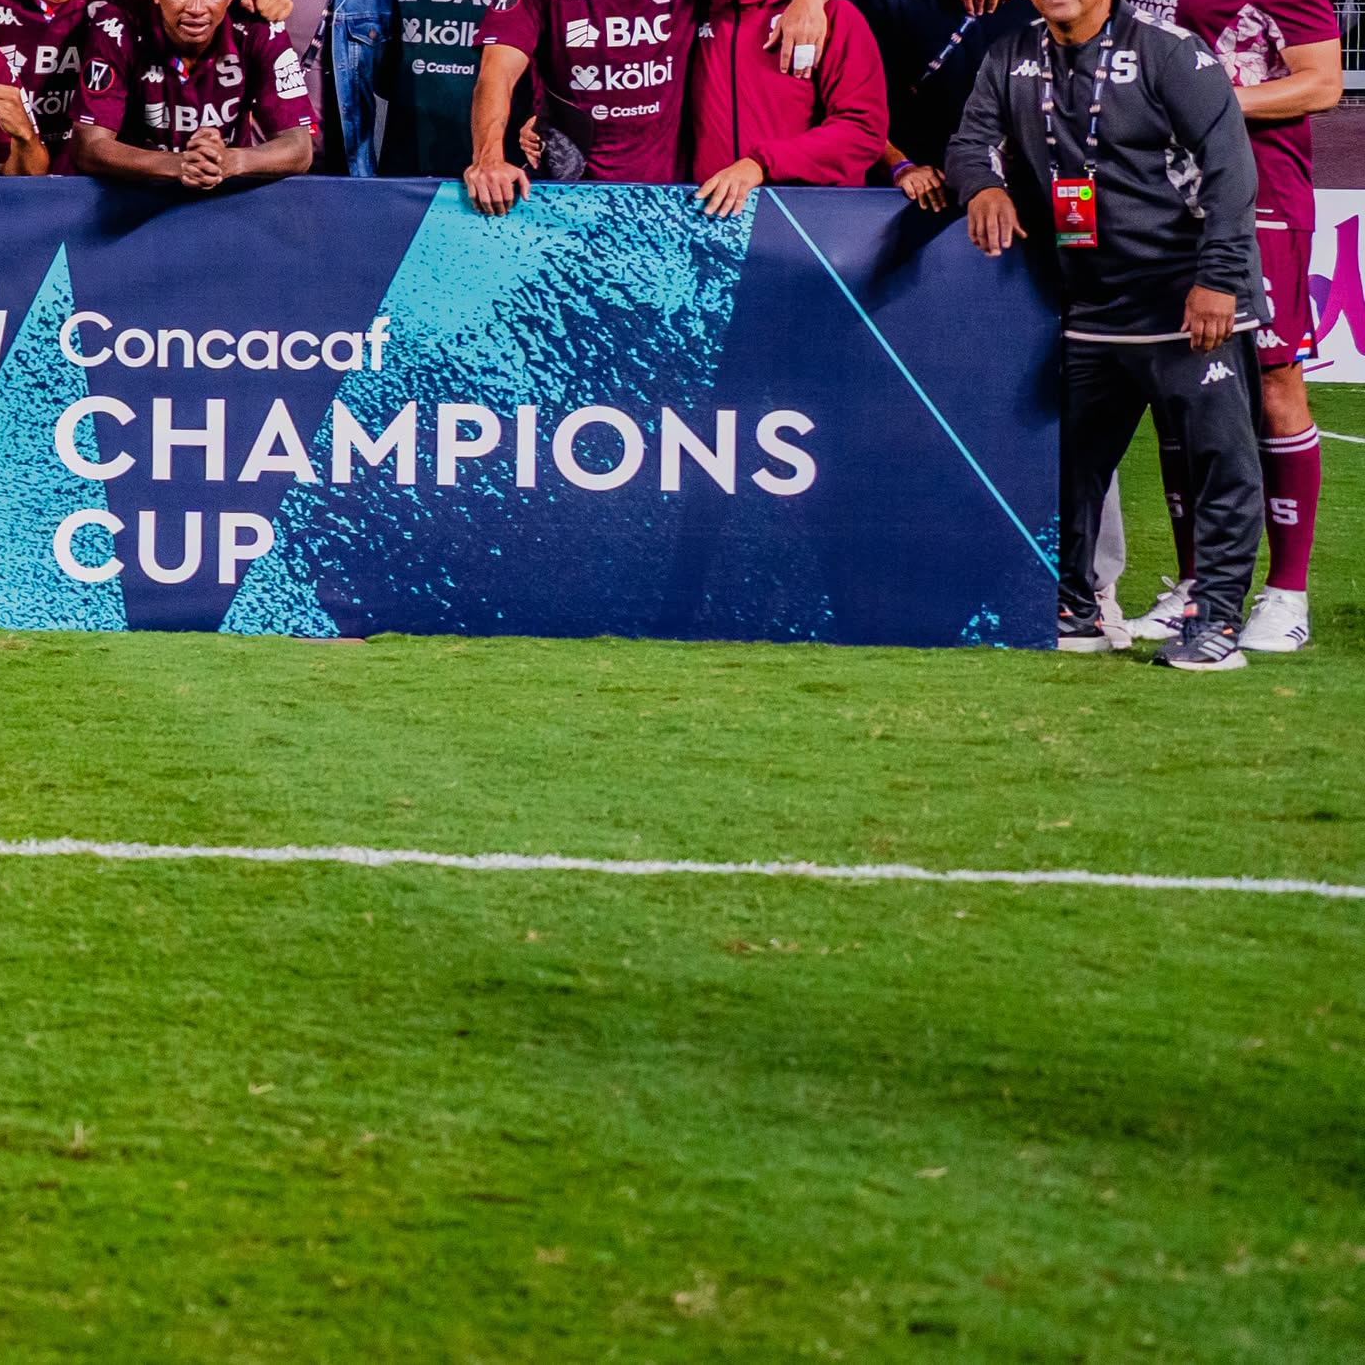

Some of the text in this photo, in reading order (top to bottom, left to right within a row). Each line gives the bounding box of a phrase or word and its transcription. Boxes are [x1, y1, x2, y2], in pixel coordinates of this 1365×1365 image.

[605, 14, 671, 47] BAC
[35, 46, 81, 73] BA
[216, 54, 244, 86] S
[427, 62, 475, 75] Castrol
[605, 56, 673, 90] kölbi
[1110, 50, 1138, 83] S
[175, 97, 241, 132] BAC
[610, 101, 660, 118] Castrol
[60, 311, 388, 373] Concacaf
[55, 397, 817, 495] CHAMPIONS
[1272, 499, 1298, 525] S
[53, 507, 277, 586] CUP
